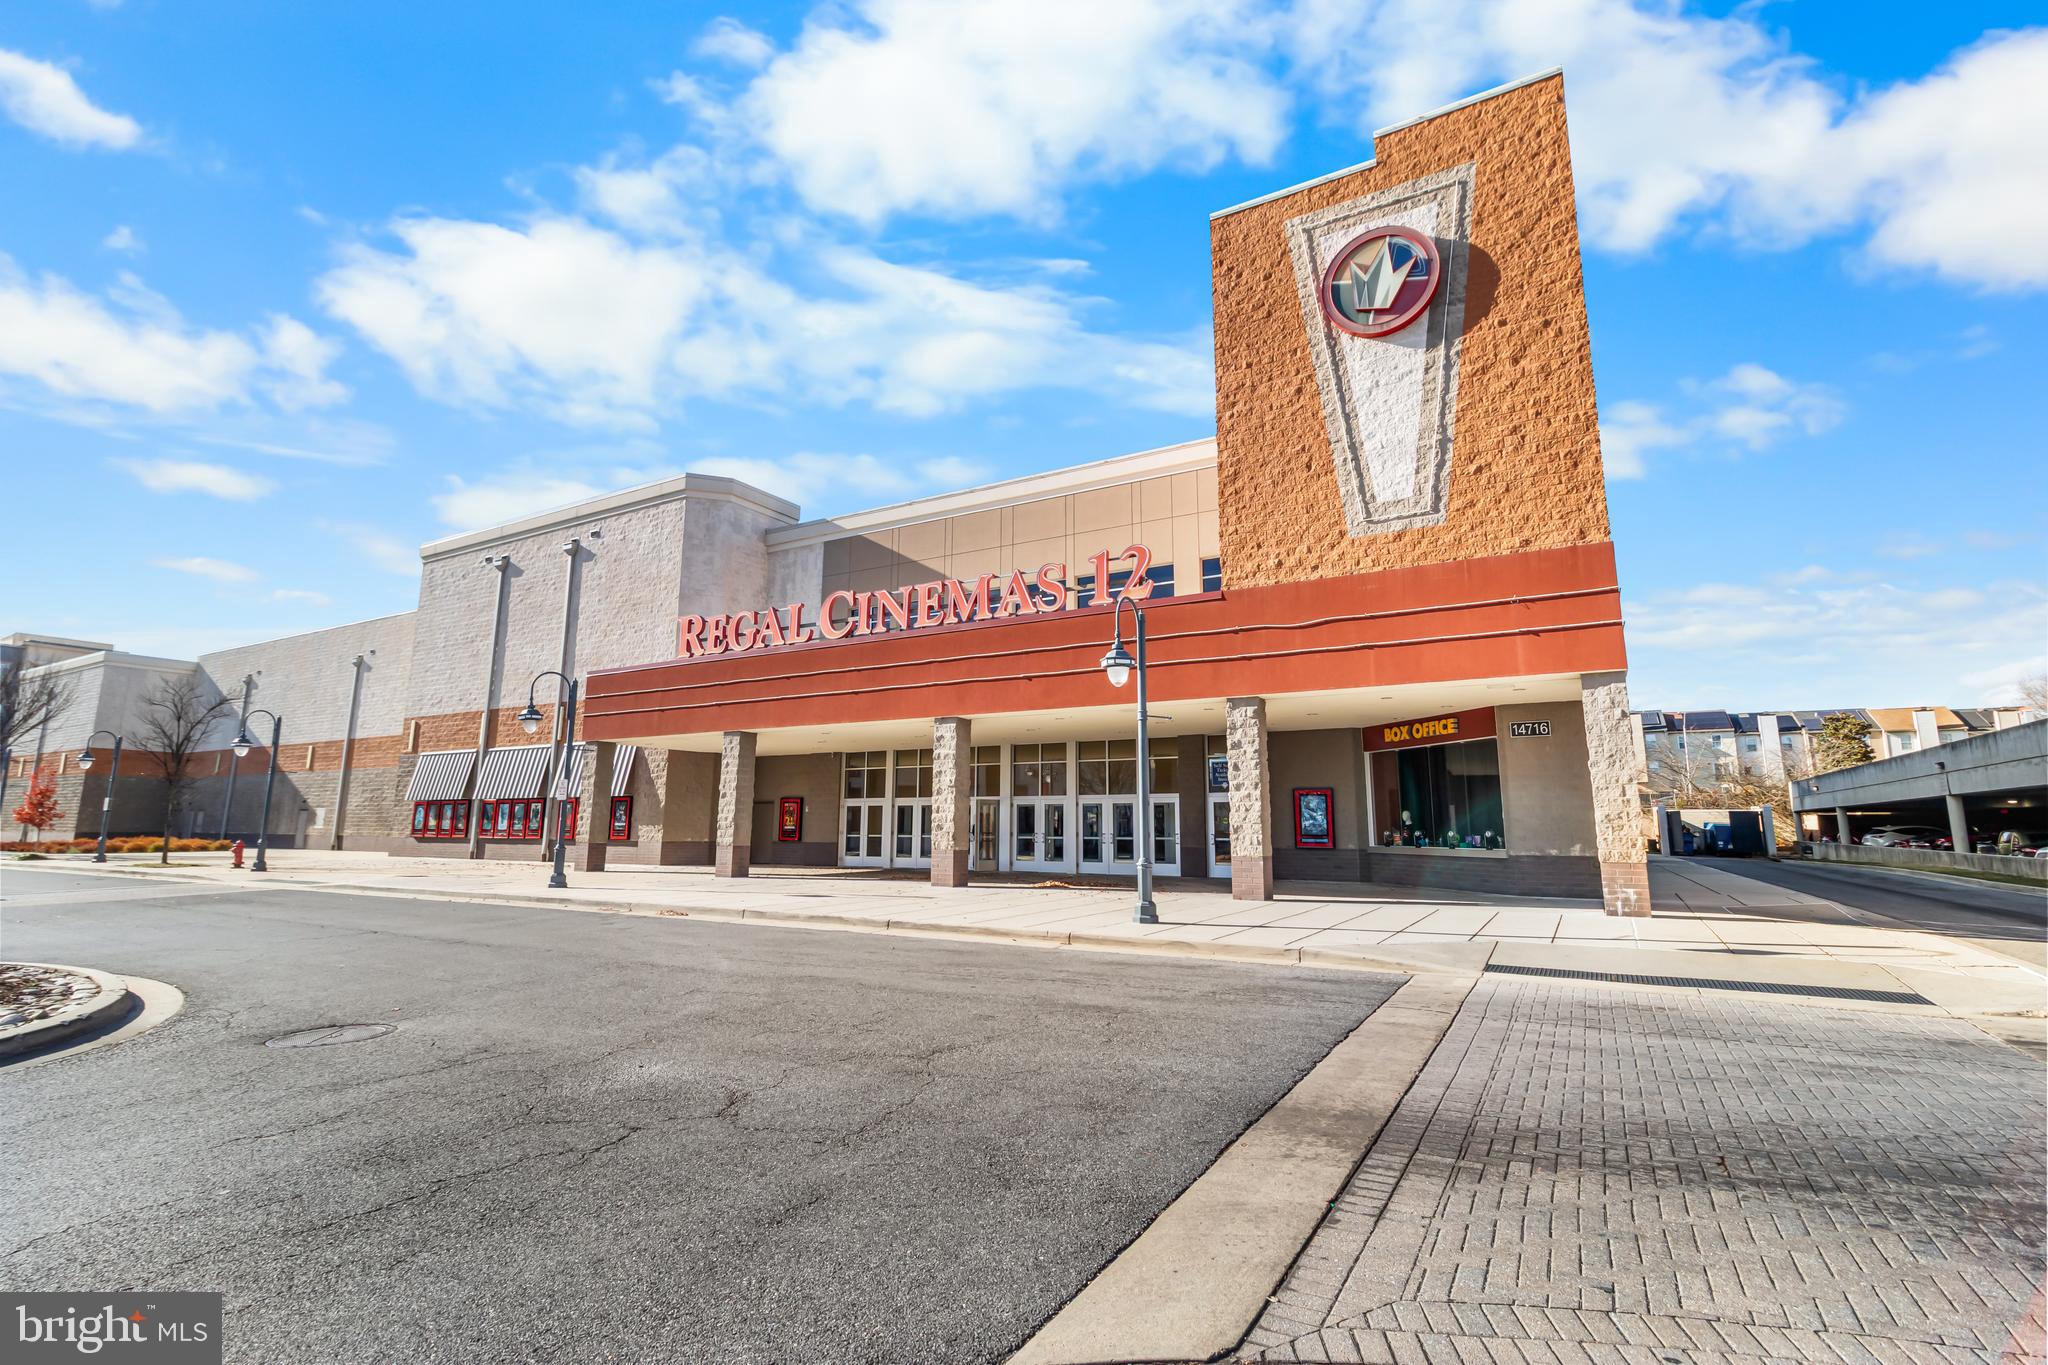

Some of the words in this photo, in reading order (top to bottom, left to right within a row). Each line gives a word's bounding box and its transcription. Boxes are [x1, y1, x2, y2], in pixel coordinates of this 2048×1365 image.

[677, 602, 814, 658] REGAL
[819, 562, 1067, 640] CINEMAS
[1088, 543, 1155, 607] 12
[1383, 722, 1410, 743] BOX
[1412, 717, 1458, 739] OFFICE
[1512, 722, 1549, 736] 14716
